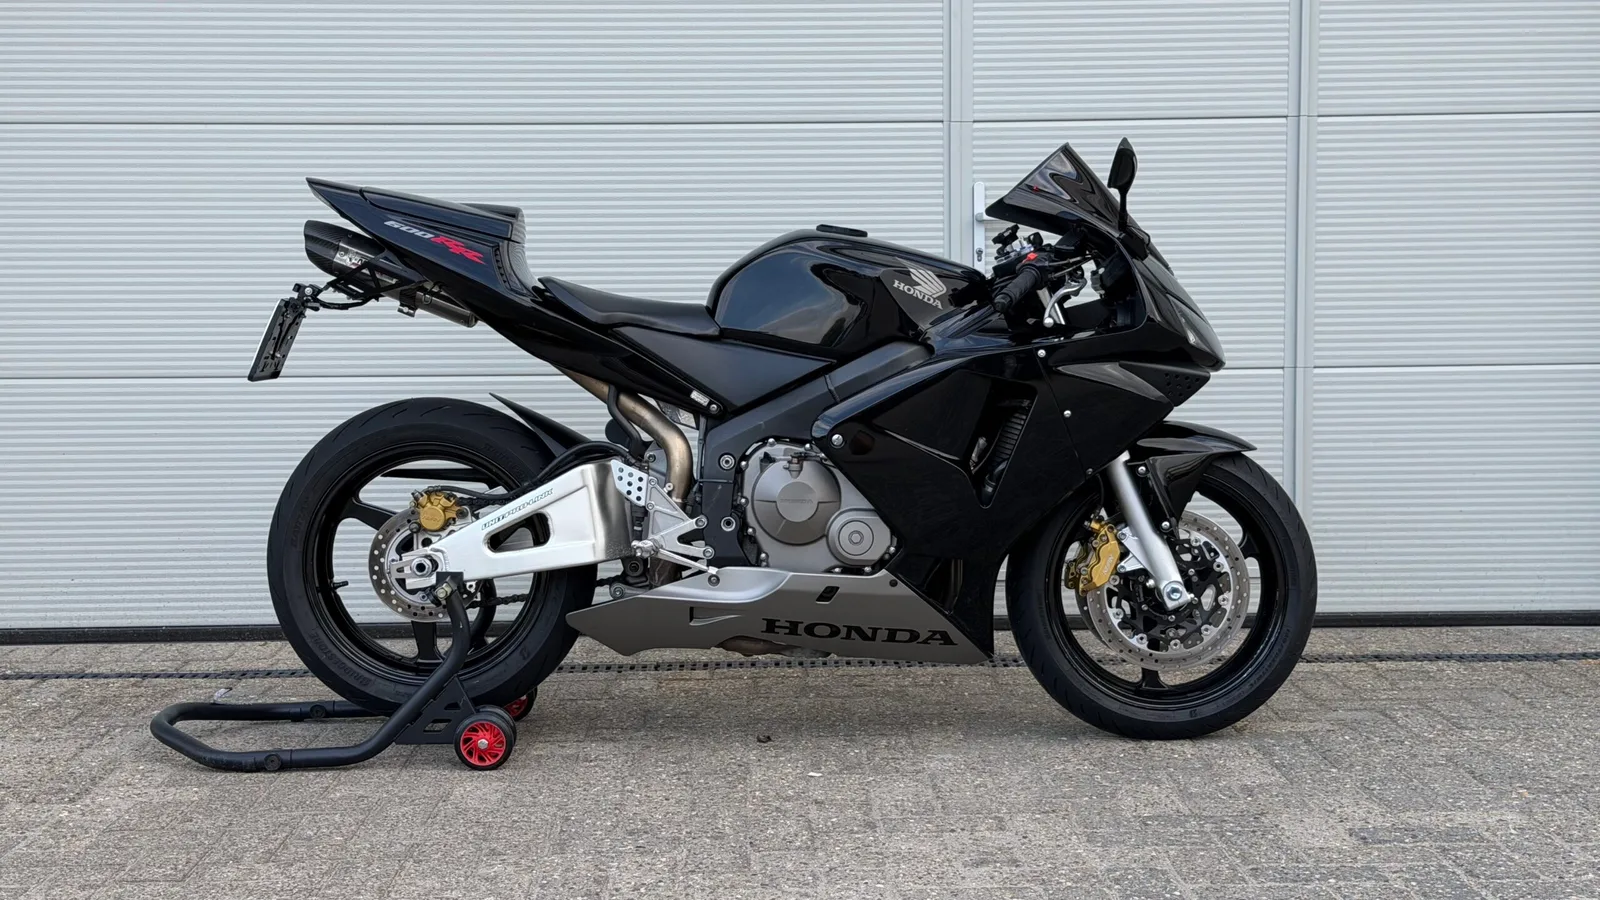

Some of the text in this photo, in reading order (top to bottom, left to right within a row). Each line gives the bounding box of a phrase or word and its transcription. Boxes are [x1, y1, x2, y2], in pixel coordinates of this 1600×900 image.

[384, 220, 435, 239] 600
[892, 279, 943, 310] HONDA
[761, 618, 958, 646] HONDA
